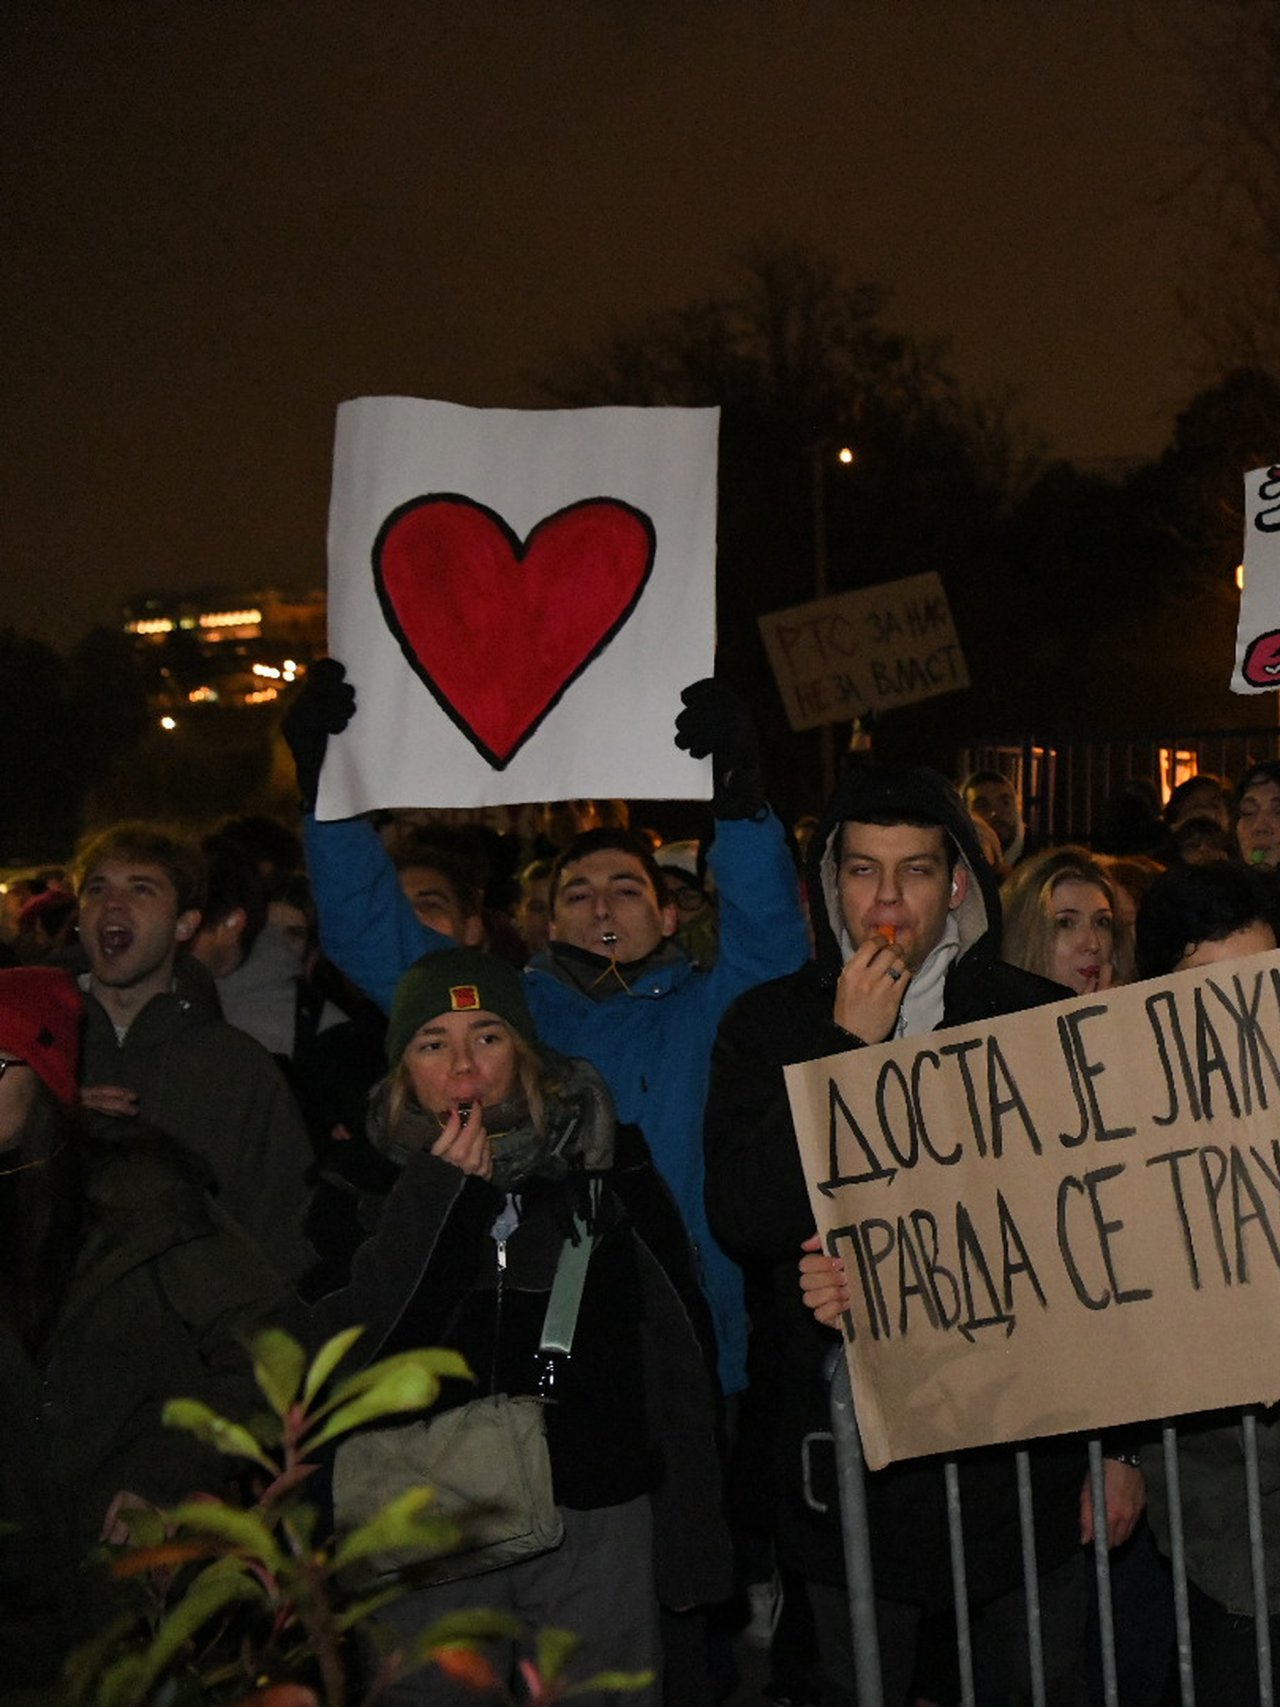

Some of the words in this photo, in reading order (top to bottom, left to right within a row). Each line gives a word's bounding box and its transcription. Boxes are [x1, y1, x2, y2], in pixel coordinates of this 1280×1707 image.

[817, 1034, 1043, 1197] ДОСТА
[1057, 1004, 1136, 1147] ЈЕ
[826, 1187, 1048, 1342] ПРАВДА
[1057, 1163, 1152, 1310] СЕ
